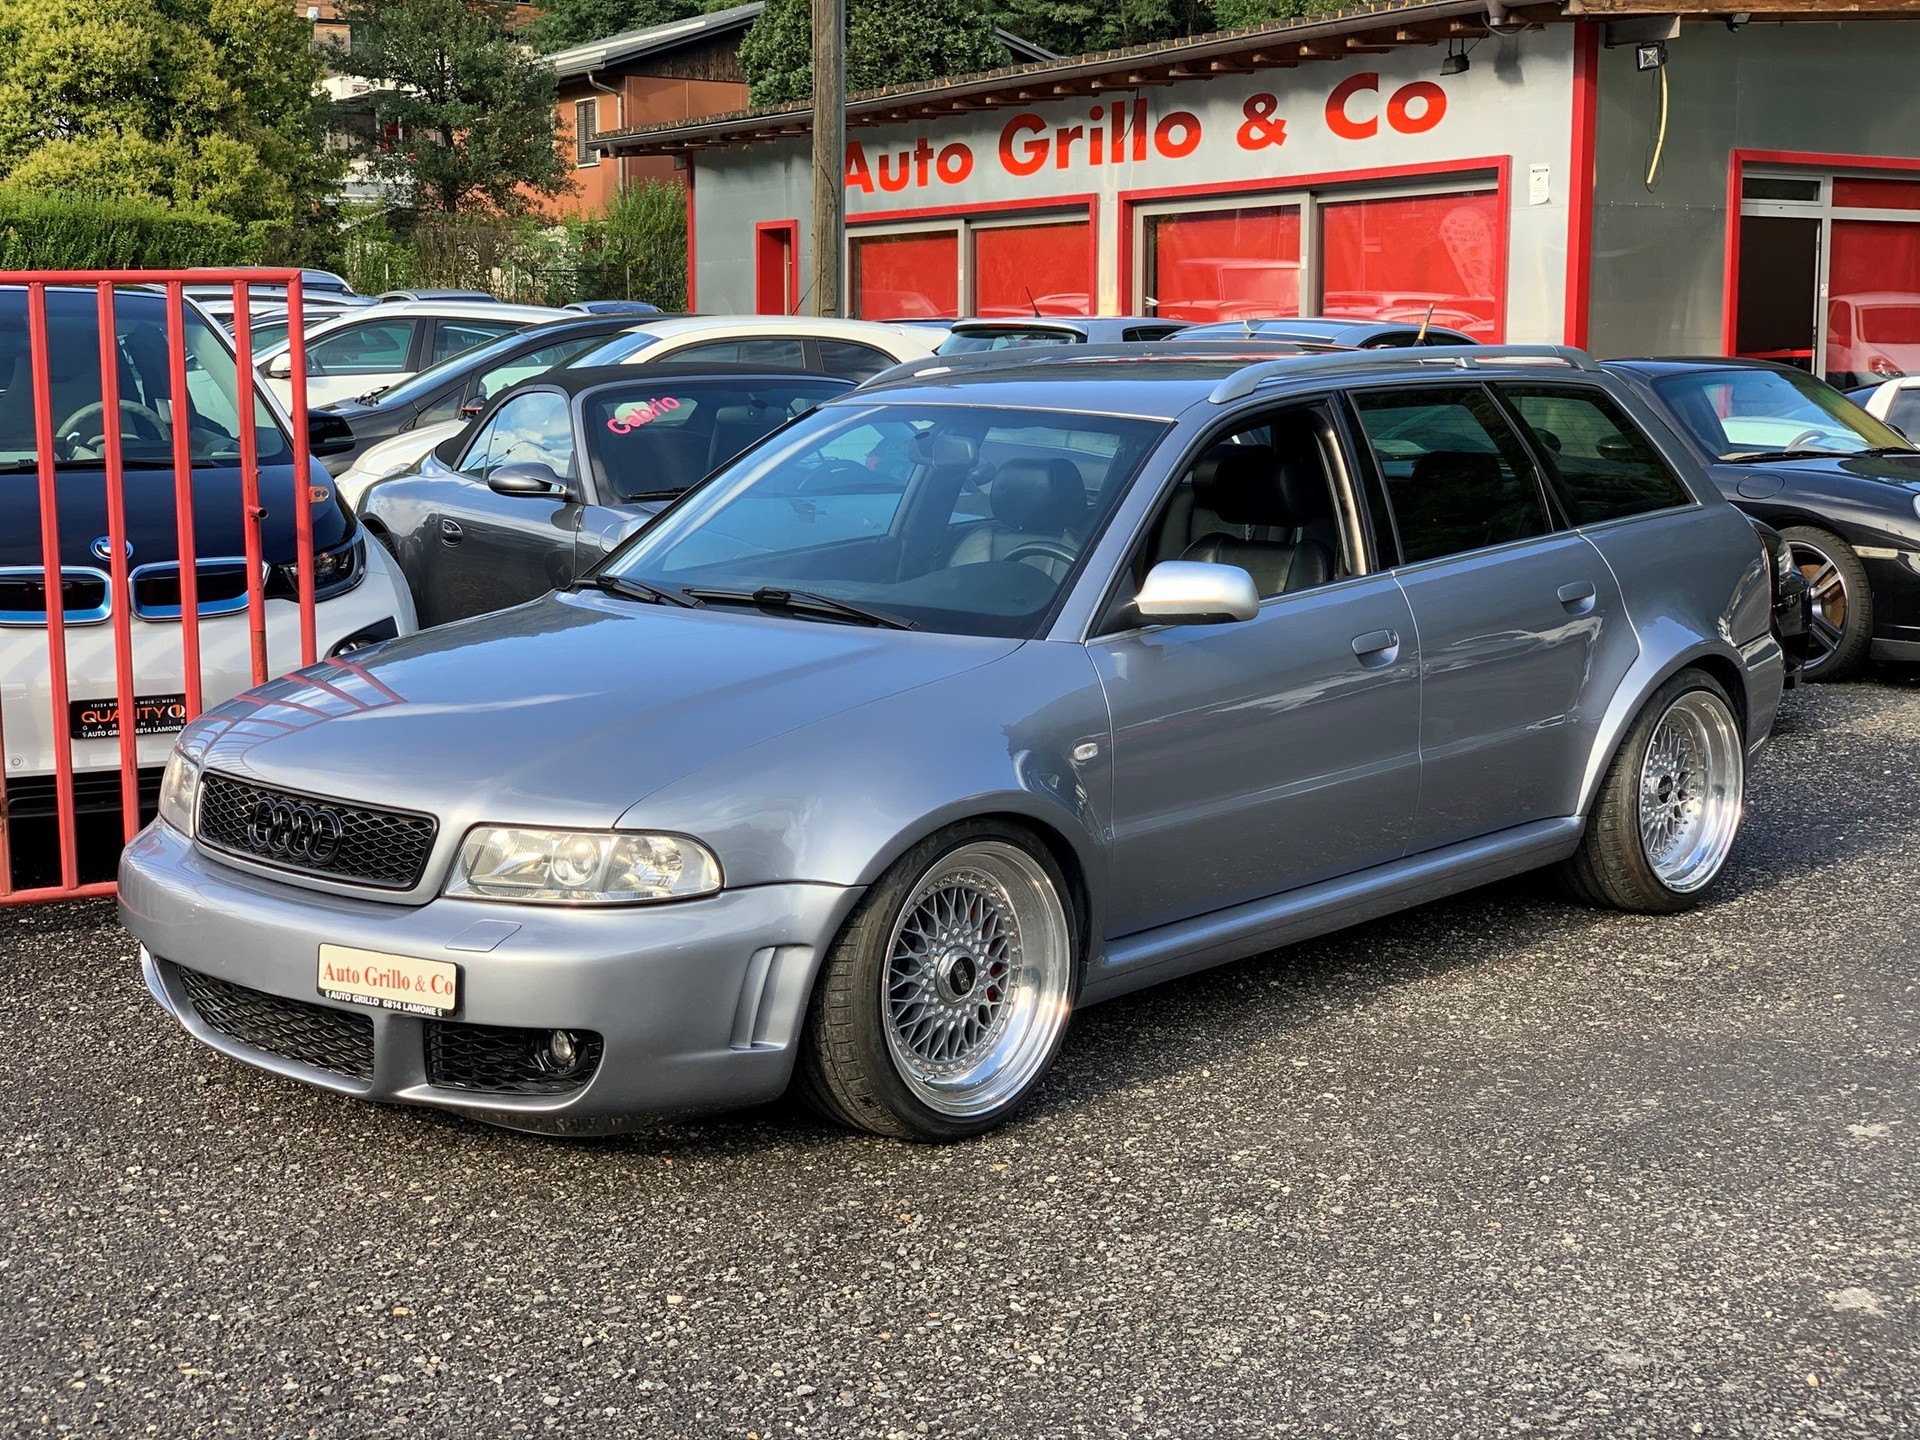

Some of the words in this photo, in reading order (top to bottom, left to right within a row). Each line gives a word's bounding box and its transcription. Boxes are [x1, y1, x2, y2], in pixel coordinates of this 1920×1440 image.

[845, 139, 974, 193] Auto
[999, 98, 1203, 177] Grillo
[1236, 93, 1288, 151] &
[1325, 72, 1448, 141] Co
[607, 397, 680, 434] Cabrio
[81, 706, 165, 723] QUAITY
[82, 719, 186, 731] GARNTIE
[87, 730, 106, 738] AUTO
[152, 724, 182, 733] LAMONE
[323, 962, 360, 985] Auto
[364, 966, 410, 991] Grillo
[414, 975, 426, 993] &
[430, 973, 453, 996] Co
[330, 991, 351, 1002] AUTO
[352, 995, 380, 1006] GRILLO
[382, 999, 402, 1010] 6814
[402, 1004, 436, 1016] LAMONE
